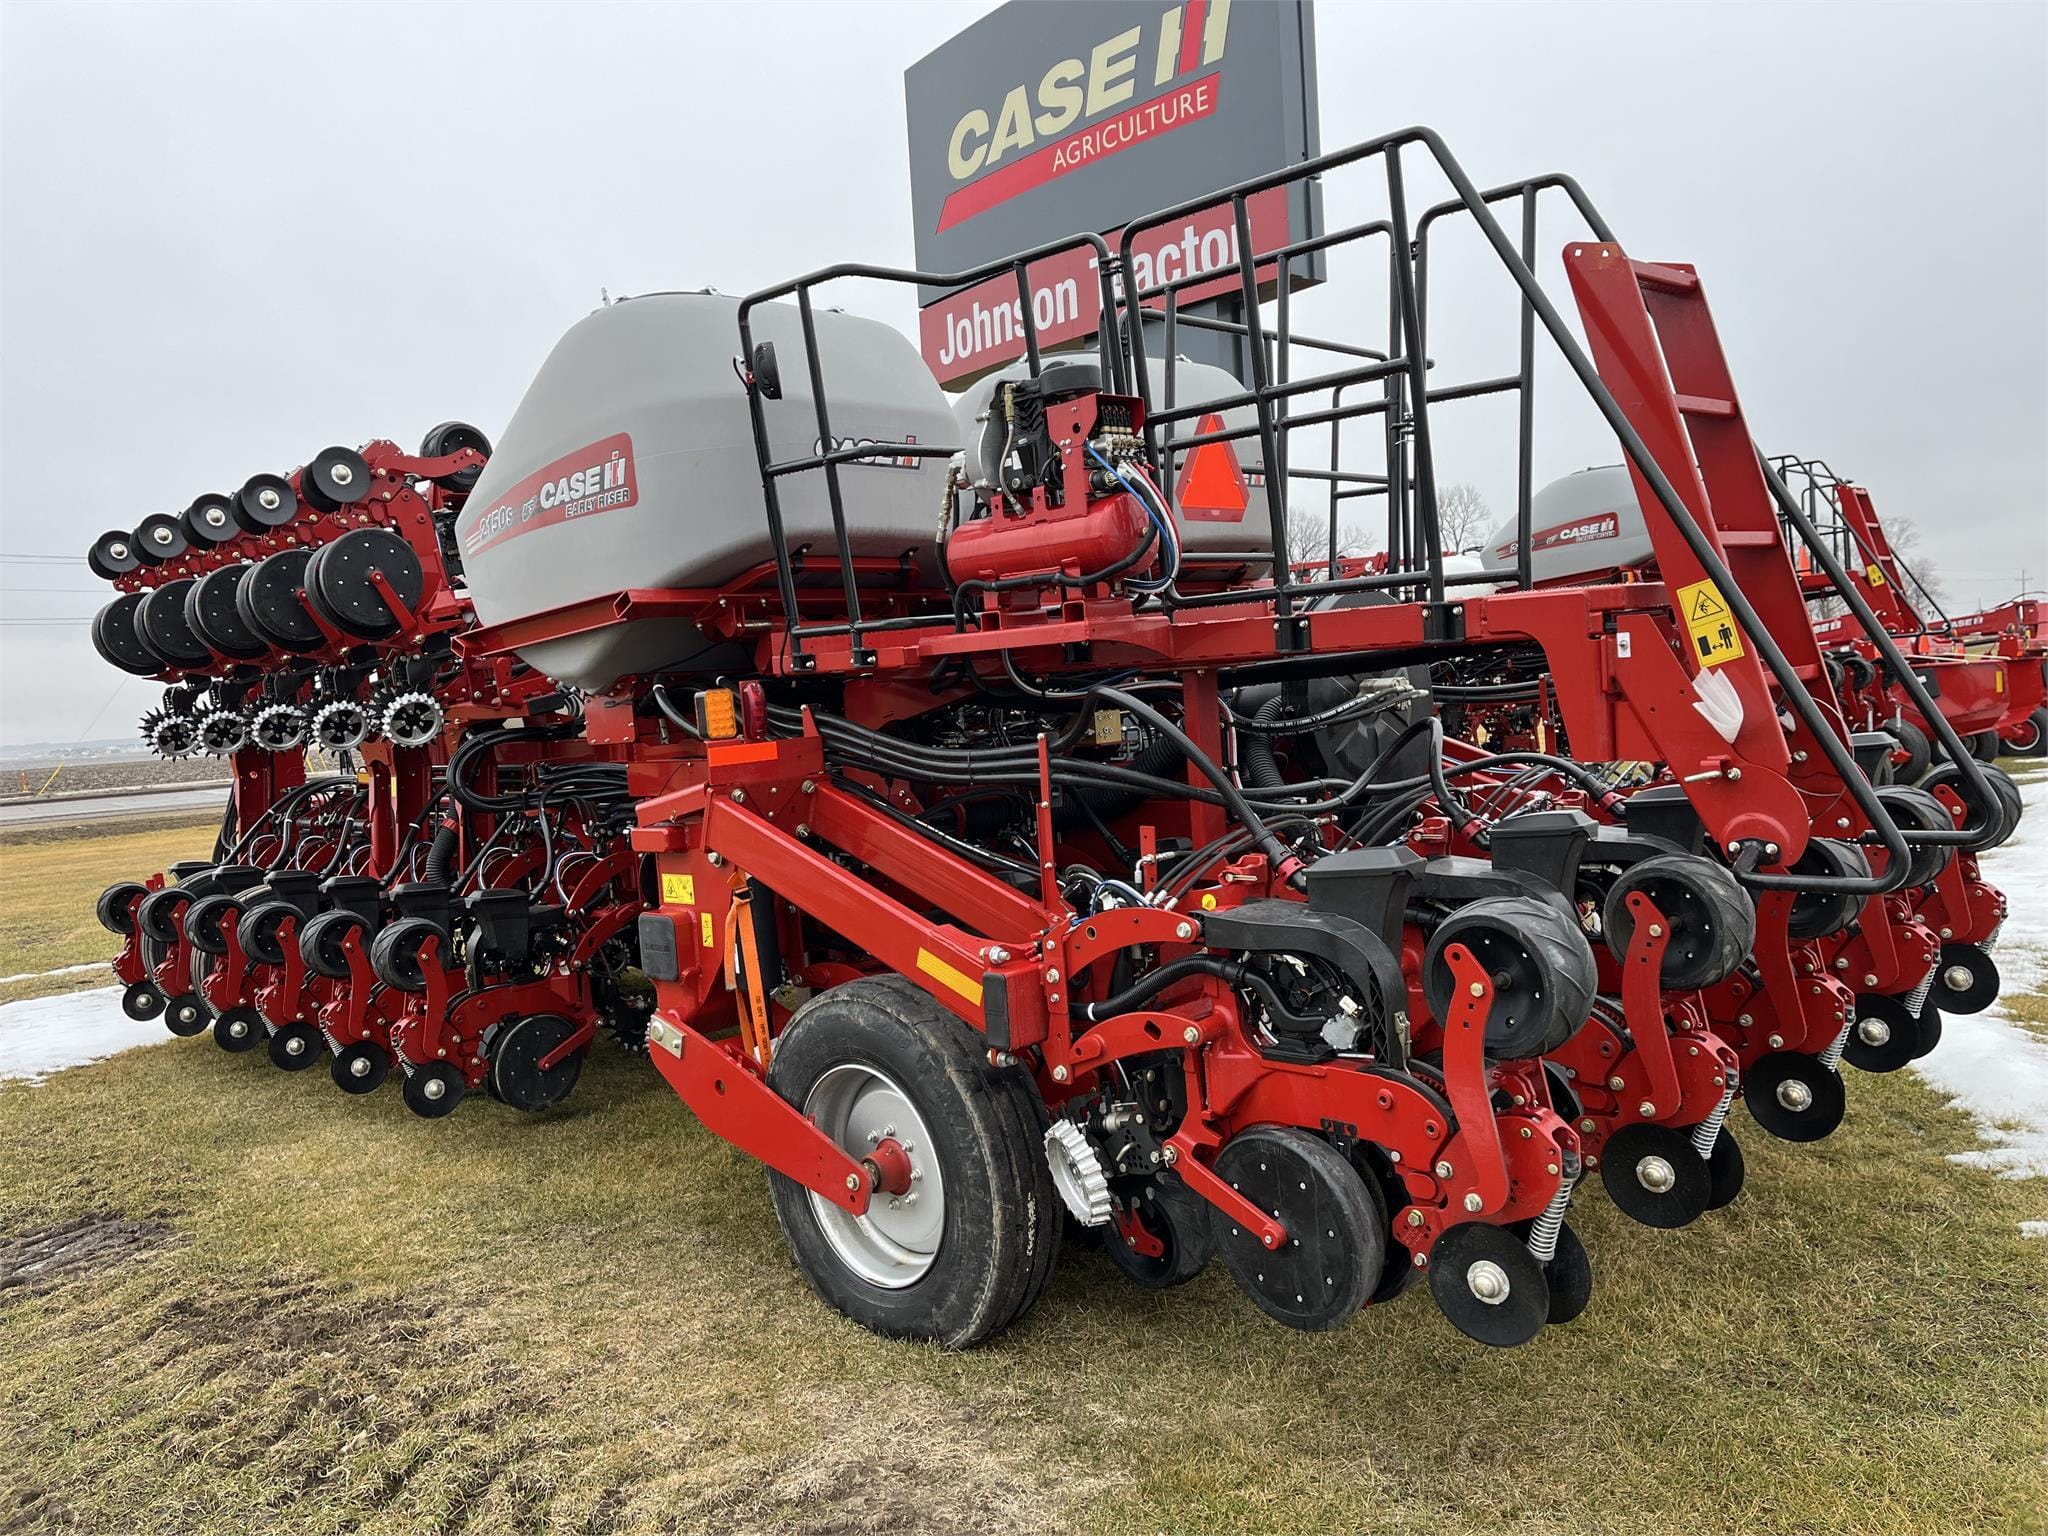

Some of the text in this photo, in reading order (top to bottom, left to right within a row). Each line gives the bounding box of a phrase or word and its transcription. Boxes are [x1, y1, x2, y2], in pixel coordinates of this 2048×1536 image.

[947, 25, 1142, 181] CASE
[1052, 85, 1210, 173] AGRICULTURE
[939, 218, 1251, 366] Johnson acto
[540, 465, 601, 509] CASE
[604, 450, 626, 490] IH
[565, 487, 630, 519] EARLY RISER
[1560, 523, 1600, 540] CASE
